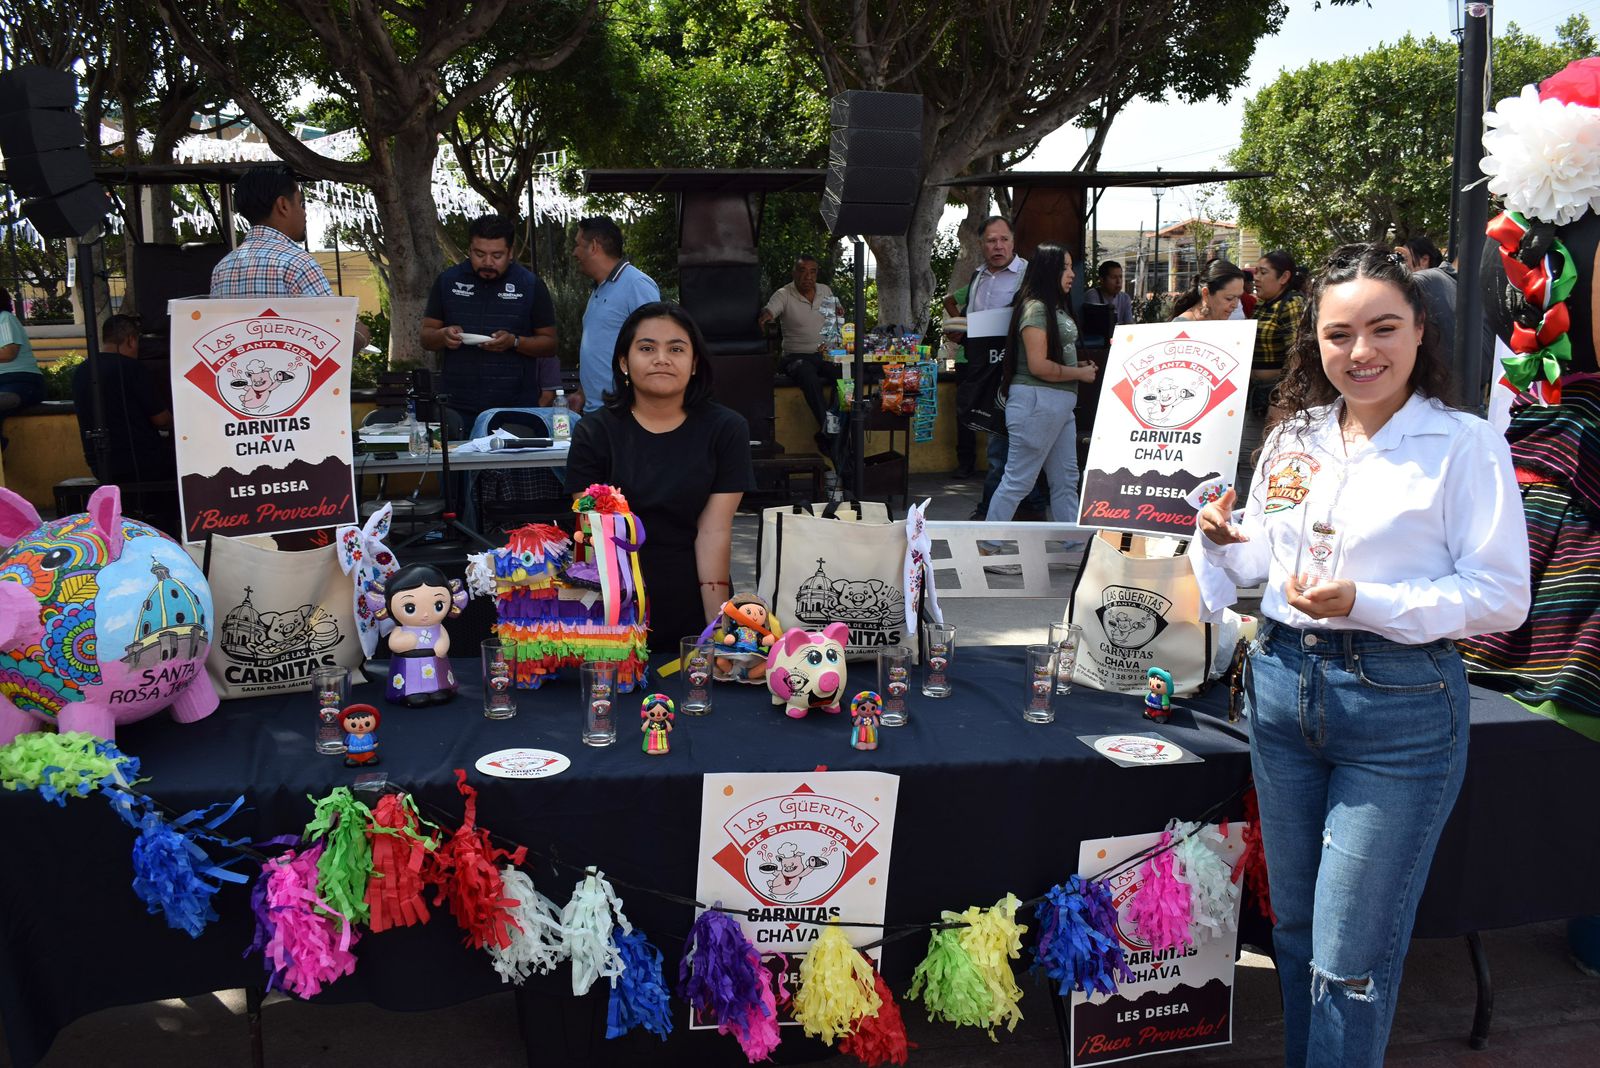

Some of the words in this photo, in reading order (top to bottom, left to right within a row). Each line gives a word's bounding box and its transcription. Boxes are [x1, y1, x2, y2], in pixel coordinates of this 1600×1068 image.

[202, 333, 236, 355] LAS
[246, 320, 327, 351] GÜERITAS
[217, 353, 232, 367] DE
[236, 341, 278, 355] SANTA
[283, 343, 313, 362] ROSA
[1130, 353, 1155, 372] LAS
[1136, 371, 1150, 383] DE
[1153, 361, 1187, 373] SANTA
[224, 416, 311, 437] CARNITAS
[1130, 430, 1202, 445] CARNITAS
[236, 438, 296, 456] CHAVA
[1134, 448, 1184, 462] CHAVA
[230, 485, 256, 498] LES
[261, 480, 309, 496] DESEA
[1120, 484, 1142, 496] LES
[1145, 485, 1188, 499] DESEA
[190, 508, 251, 533] ¡Buen
[256, 494, 351, 523] Provecho!
[1083, 500, 1131, 519] ¡Buen
[1106, 590, 1116, 602] LAS
[257, 657, 280, 667] FERIA
[281, 653, 290, 662] DE
[291, 651, 307, 660] LAS
[1100, 642, 1154, 660] CARNITAS
[225, 654, 337, 684] CARNITAS
[1105, 657, 1140, 669] CHAVA
[139, 662, 195, 688] SANTA
[1111, 672, 1126, 681] 138
[109, 687, 159, 704] ROSA
[241, 685, 265, 693] SANTA
[734, 812, 768, 835] LAS
[779, 797, 864, 833] GÜERITAS
[747, 835, 763, 849] DE
[768, 821, 813, 836] SANTA
[818, 823, 849, 846] ROSA
[1117, 889, 1132, 902] DE
[747, 906, 841, 922] CARNITAS
[756, 928, 820, 943] CHAVA
[1117, 1010, 1140, 1023] LES
[1145, 1002, 1189, 1020] DESEA
[1077, 1034, 1133, 1056] ¡Buen
[1139, 1014, 1226, 1045] Provecho!
